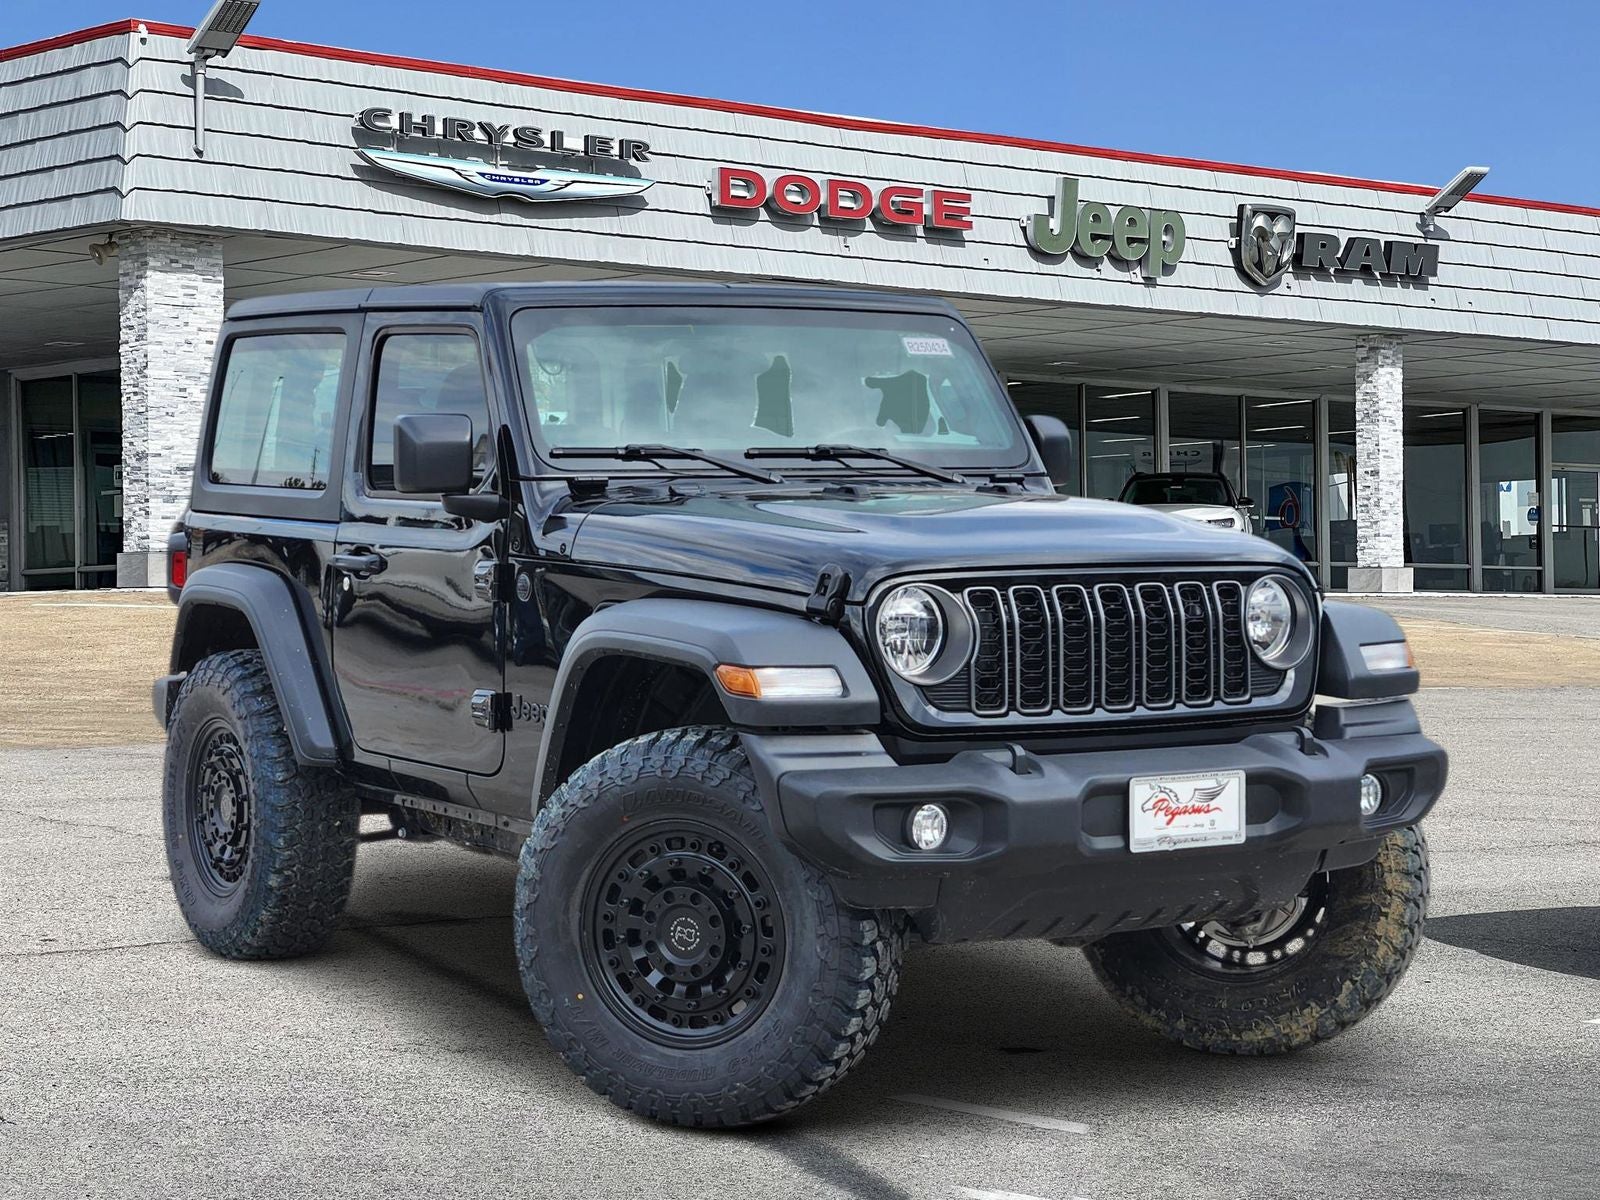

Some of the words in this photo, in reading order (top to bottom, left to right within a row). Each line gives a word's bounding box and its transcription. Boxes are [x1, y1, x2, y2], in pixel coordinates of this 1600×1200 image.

[357, 107, 650, 162] CHRYSLER
[484, 174, 541, 185] CHRYSLER
[713, 167, 973, 231] DODGE
[1026, 177, 1186, 279] Jeep
[1301, 231, 1440, 278] RAM
[1152, 798, 1222, 826] Pegasus
